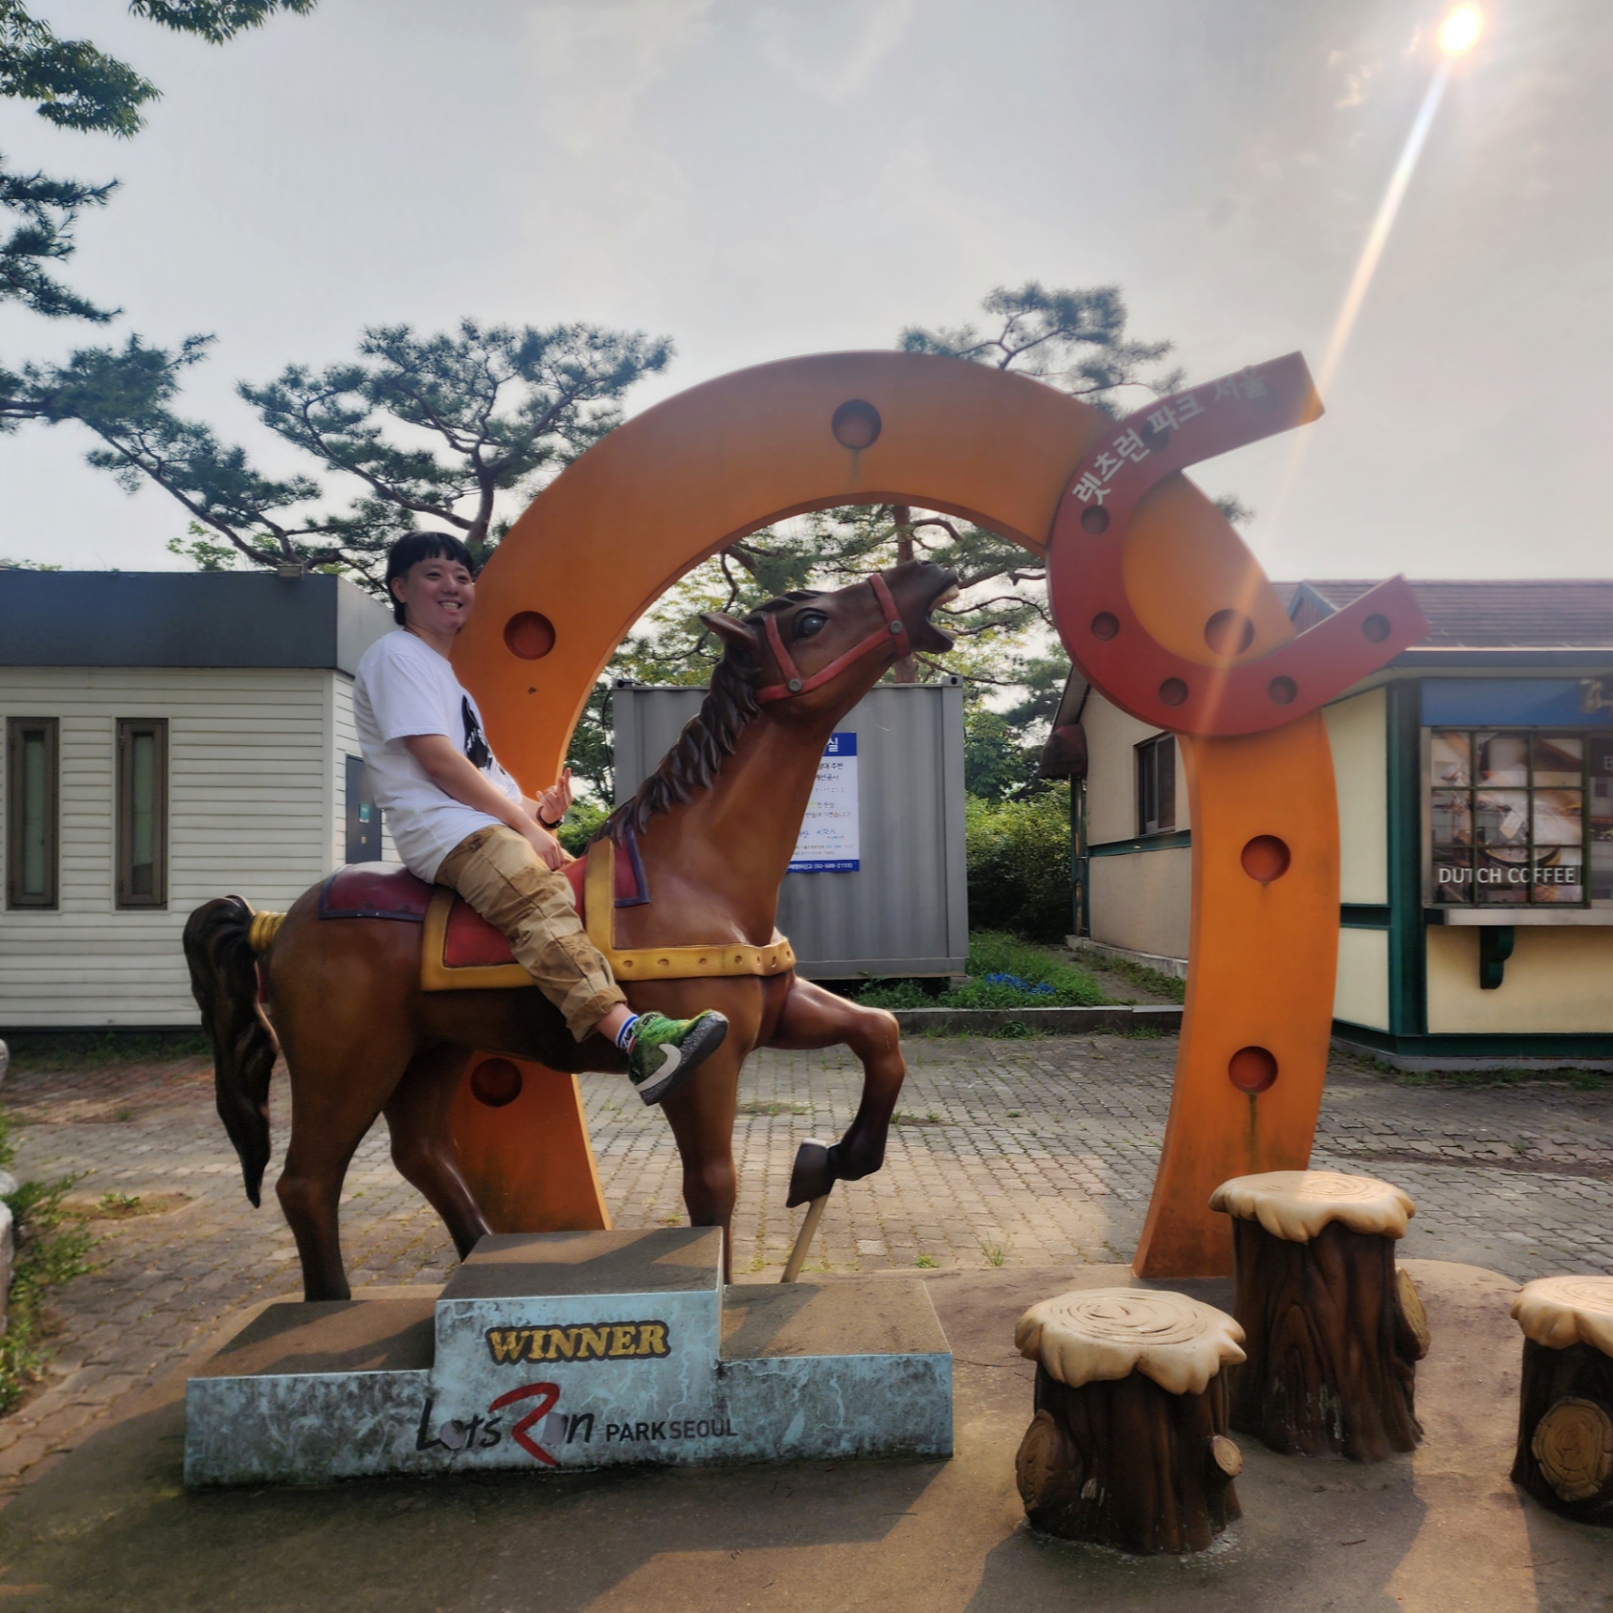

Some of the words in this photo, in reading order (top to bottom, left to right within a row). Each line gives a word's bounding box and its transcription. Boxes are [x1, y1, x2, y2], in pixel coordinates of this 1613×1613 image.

[1072, 428, 1150, 505] 렛츠런
[1147, 393, 1205, 433] 파크
[1213, 367, 1267, 401] 서울
[1439, 867, 1502, 884] DUTCH
[1507, 867, 1576, 884] COFFEE
[486, 1321, 671, 1365] WINNER
[416, 1382, 595, 1467] LtsRn
